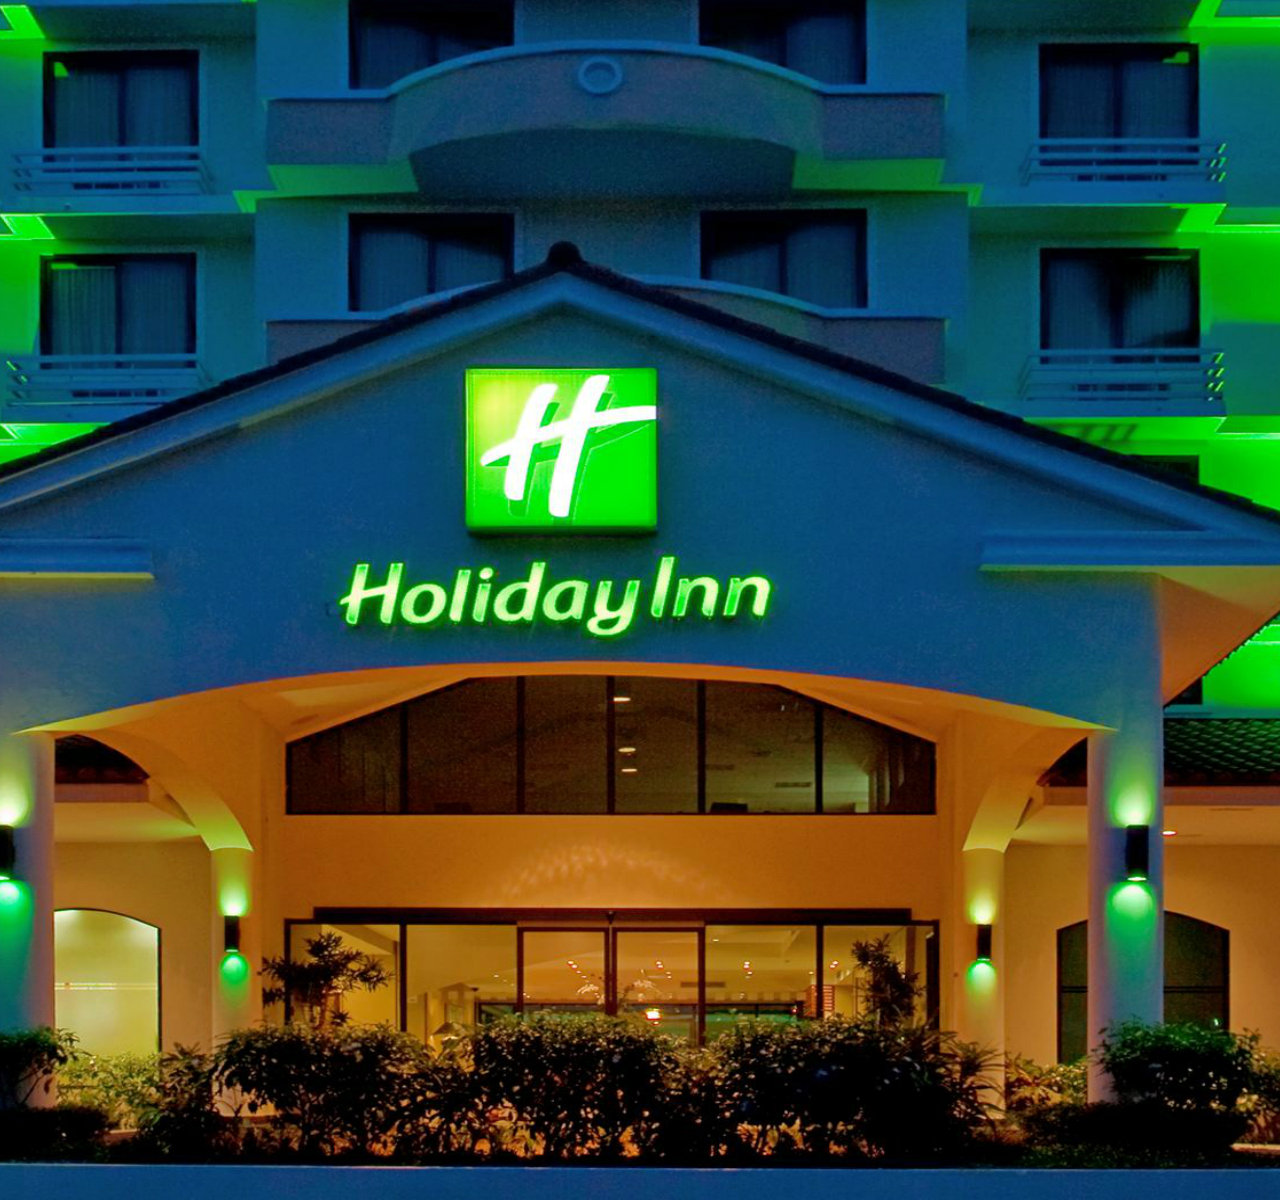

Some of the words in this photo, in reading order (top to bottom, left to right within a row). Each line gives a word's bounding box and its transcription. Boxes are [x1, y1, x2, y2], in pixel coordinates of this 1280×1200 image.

[481, 375, 657, 518] H
[338, 560, 641, 636] Holiday
[650, 556, 772, 619] Inn
